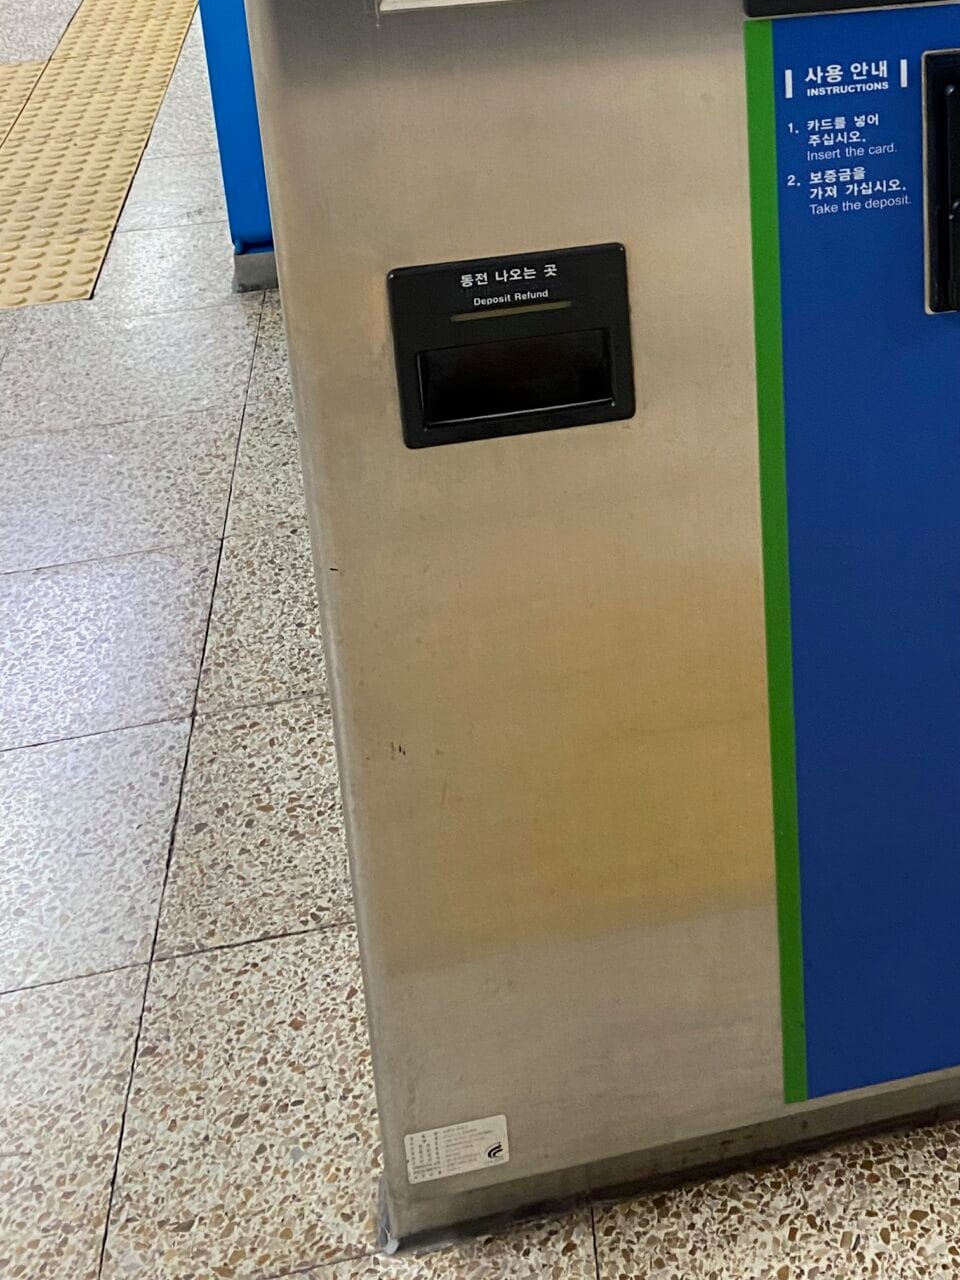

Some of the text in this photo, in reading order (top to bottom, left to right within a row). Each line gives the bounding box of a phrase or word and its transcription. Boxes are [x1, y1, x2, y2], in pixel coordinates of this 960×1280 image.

[804, 60, 888, 84] 사용 안내
[807, 81, 889, 97] INSTRUCTIONS
[788, 113, 880, 134] 1. 카드를 넣어
[808, 131, 866, 147] 주십시오.
[807, 142, 898, 161] Insert the card.
[787, 166, 866, 187] 2. 보증금을
[809, 179, 907, 200] 가져 가십시오.
[809, 194, 912, 215] Take the deposit.
[460, 264, 558, 288] 동전 나오는 곳
[473, 289, 549, 307] Deposit Refund
